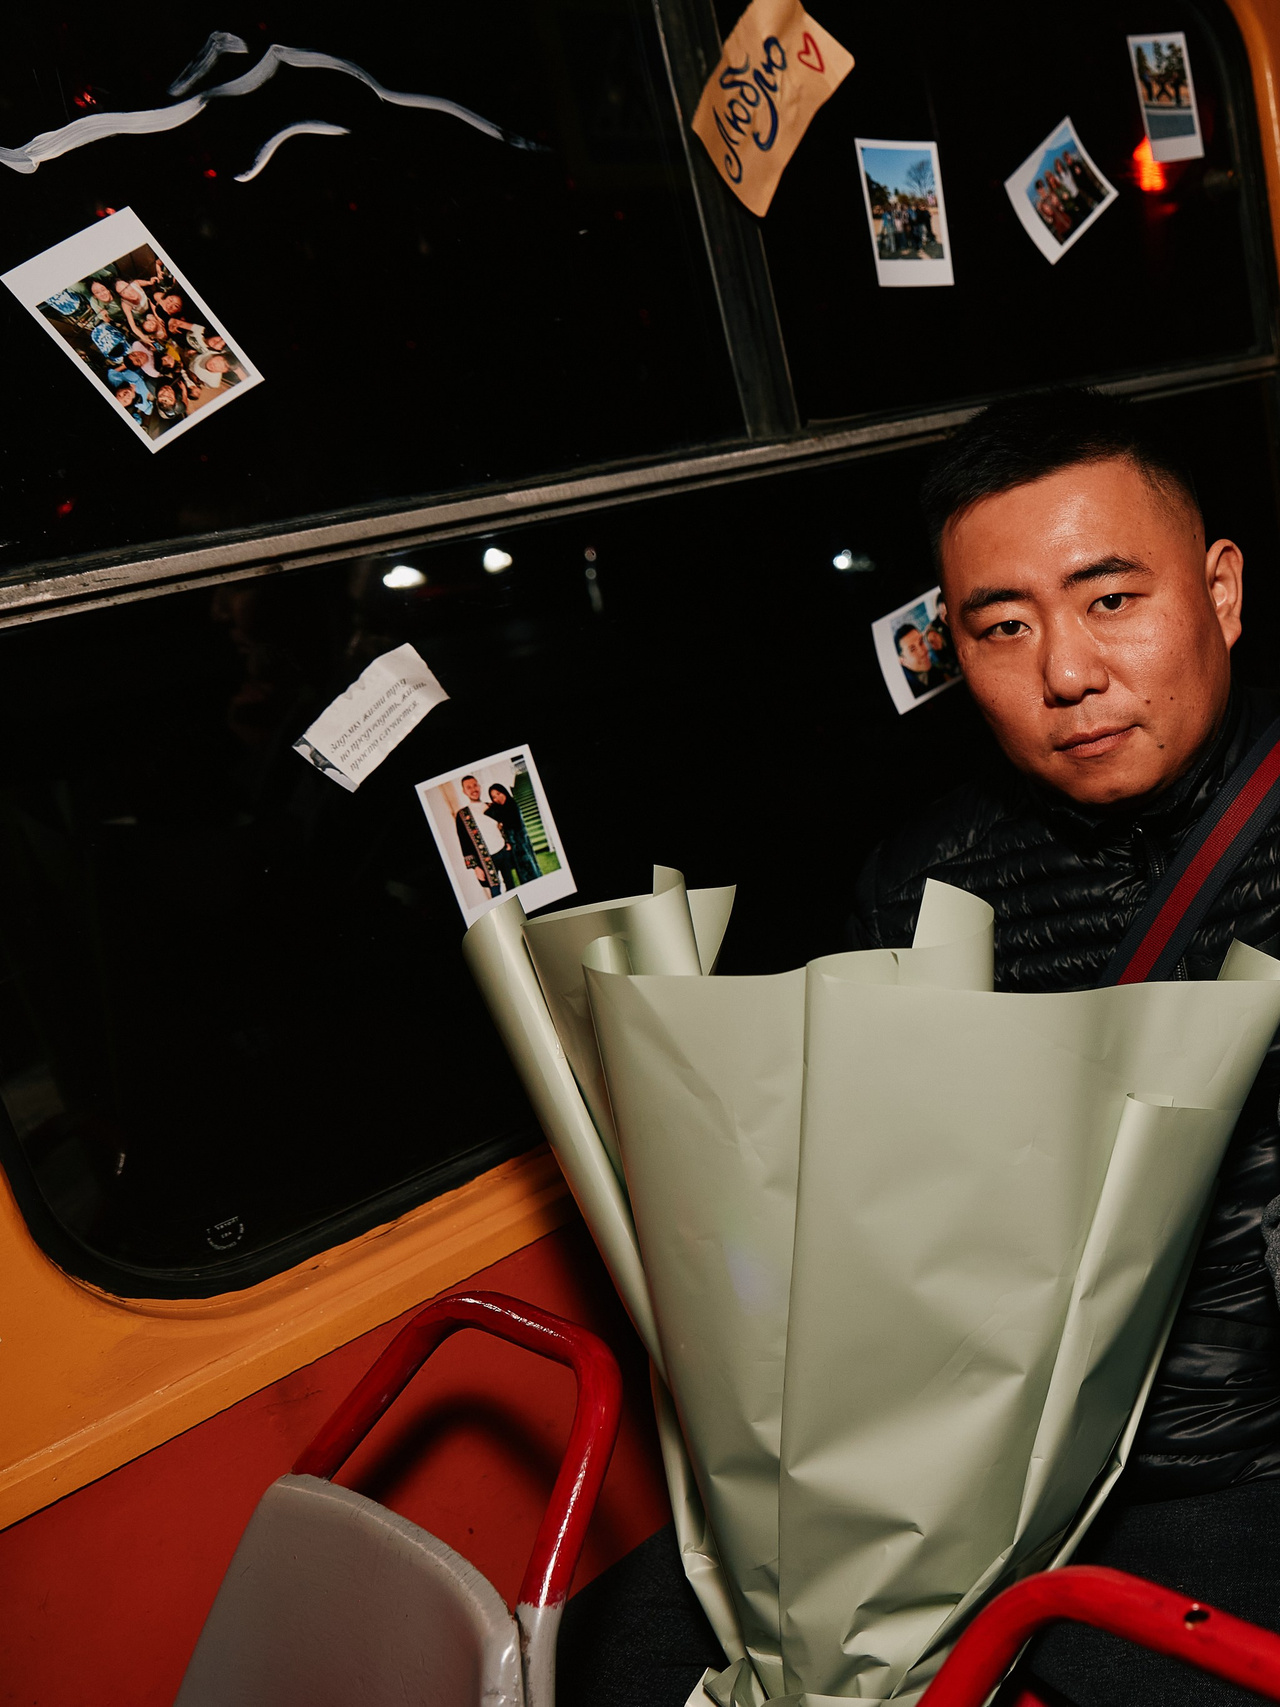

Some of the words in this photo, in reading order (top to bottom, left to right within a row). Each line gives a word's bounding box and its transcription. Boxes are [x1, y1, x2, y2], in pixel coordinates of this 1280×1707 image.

[713, 36, 787, 185] Люблю
[340, 750, 351, 763] но
[350, 739, 379, 772] просто
